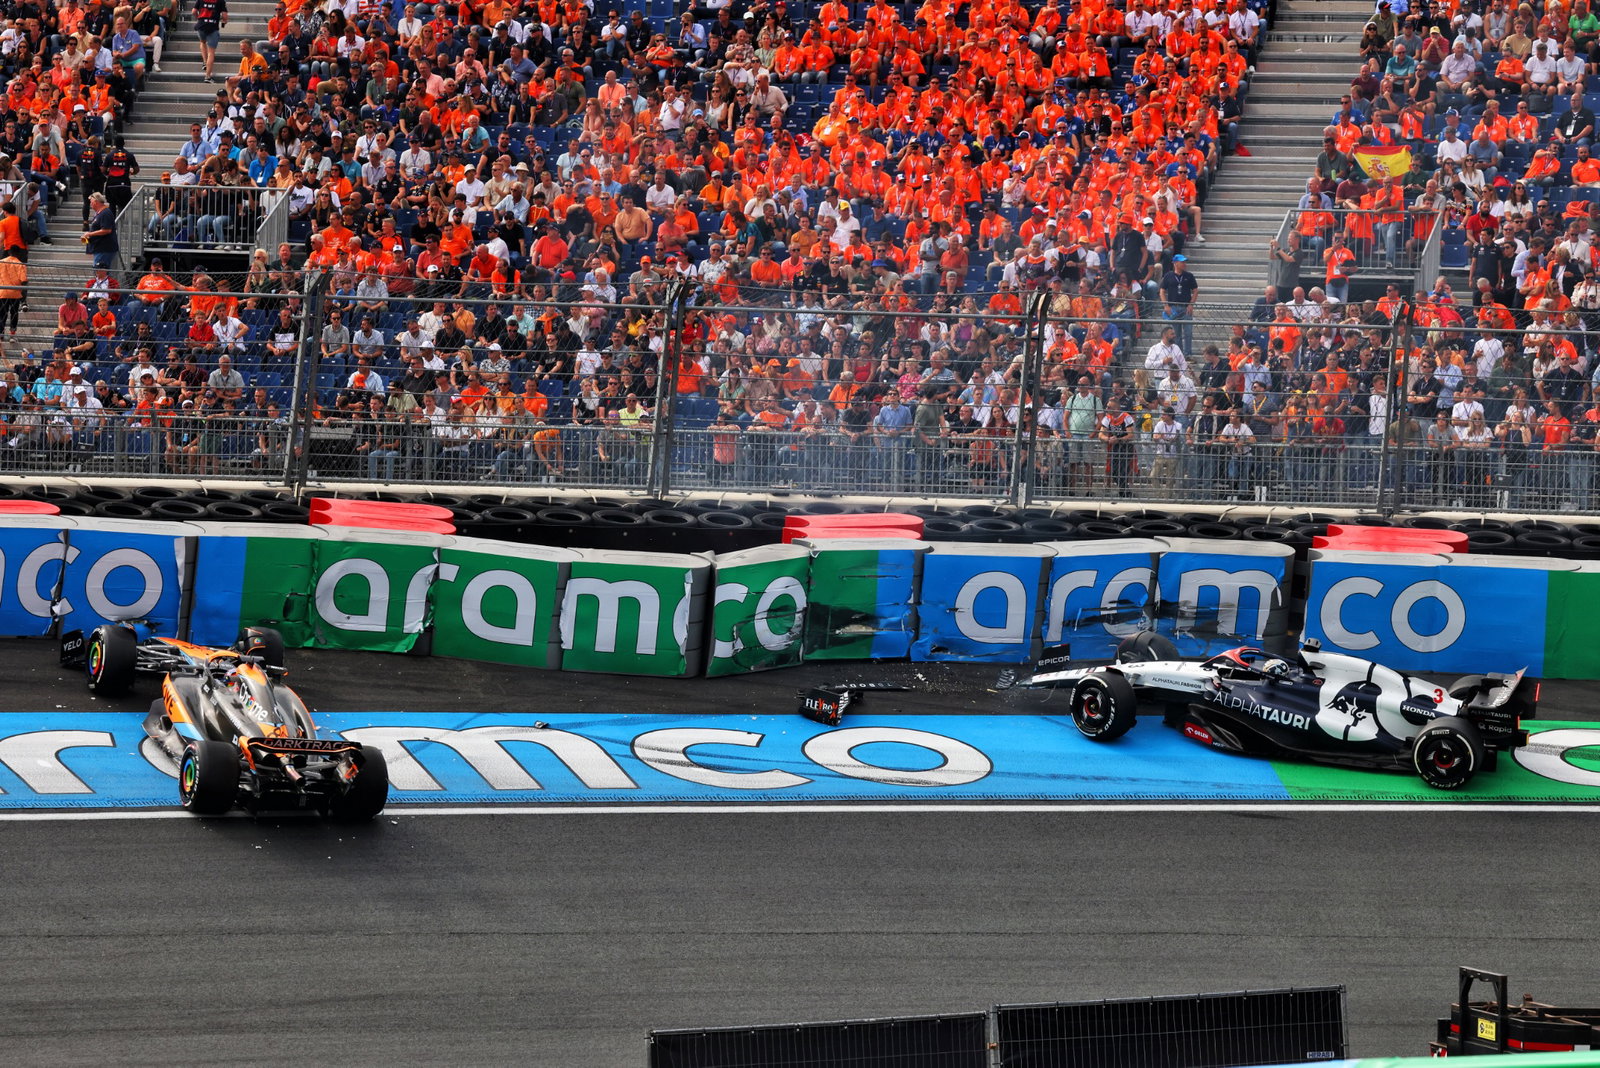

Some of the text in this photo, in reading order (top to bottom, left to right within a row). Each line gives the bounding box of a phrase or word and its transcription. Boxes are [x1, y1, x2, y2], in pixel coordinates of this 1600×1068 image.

[315, 557, 807, 658] aramco
[954, 567, 1466, 653] aramco
[63, 638, 82, 652] VELO
[1433, 688, 1444, 704] 3
[1213, 691, 1311, 730] ALPHATAURI
[1402, 705, 1436, 718] HONDA
[1488, 724, 1512, 734] Rapid
